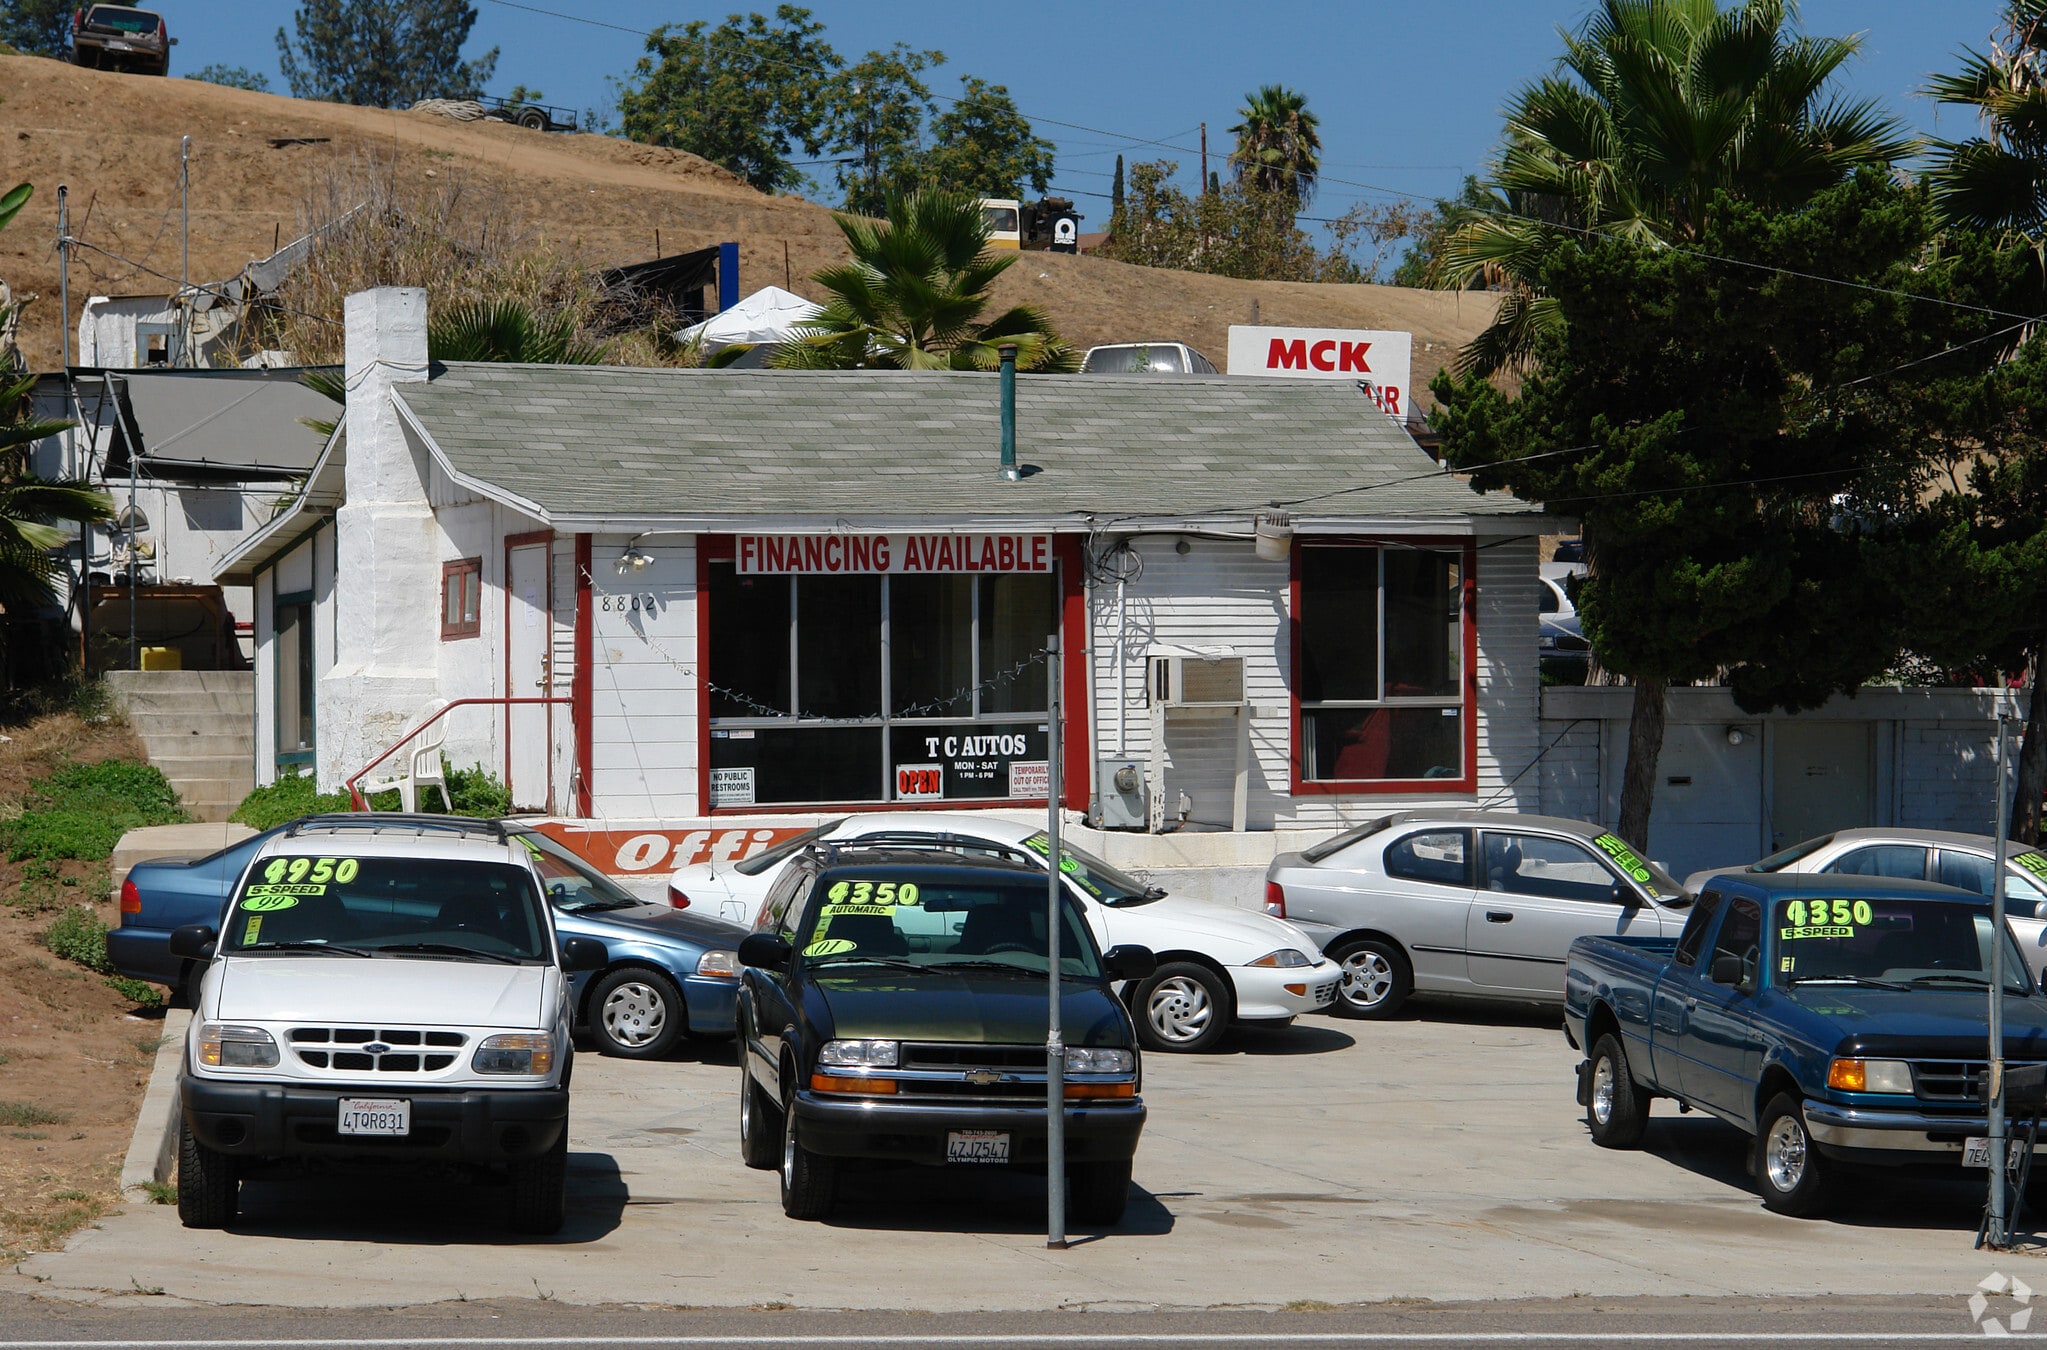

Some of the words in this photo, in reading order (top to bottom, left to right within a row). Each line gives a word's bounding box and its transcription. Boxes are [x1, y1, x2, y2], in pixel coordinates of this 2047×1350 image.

[1266, 338, 1372, 373] MCK
[741, 535, 890, 572] FINANCING
[904, 535, 1047, 571] AVAILABLE
[602, 596, 655, 611] 8802
[925, 737, 939, 757] T
[944, 736, 957, 757] C
[961, 734, 1026, 756] AUTOS
[954, 761, 975, 770] MON
[981, 761, 998, 770] SAT
[713, 772, 723, 781] NO
[724, 772, 747, 780] PUBLIC
[899, 769, 940, 794] OPEN
[1013, 777, 1024, 785] OUT
[1025, 777, 1032, 785] OF
[1033, 776, 1049, 784] OFFIC
[711, 783, 750, 791] RESTROOMS
[615, 829, 775, 871] Offi
[264, 858, 359, 884] 4950
[251, 885, 321, 895] 5-SPEED
[828, 881, 919, 906] 4350
[829, 905, 887, 914] AUTOMATIC
[1787, 900, 1873, 926] 4350
[1785, 927, 1849, 937] 5-SPEED
[353, 1101, 397, 1112] California
[343, 1112, 404, 1130] 4TQR831
[949, 1141, 1007, 1157] 4ZJZ547
